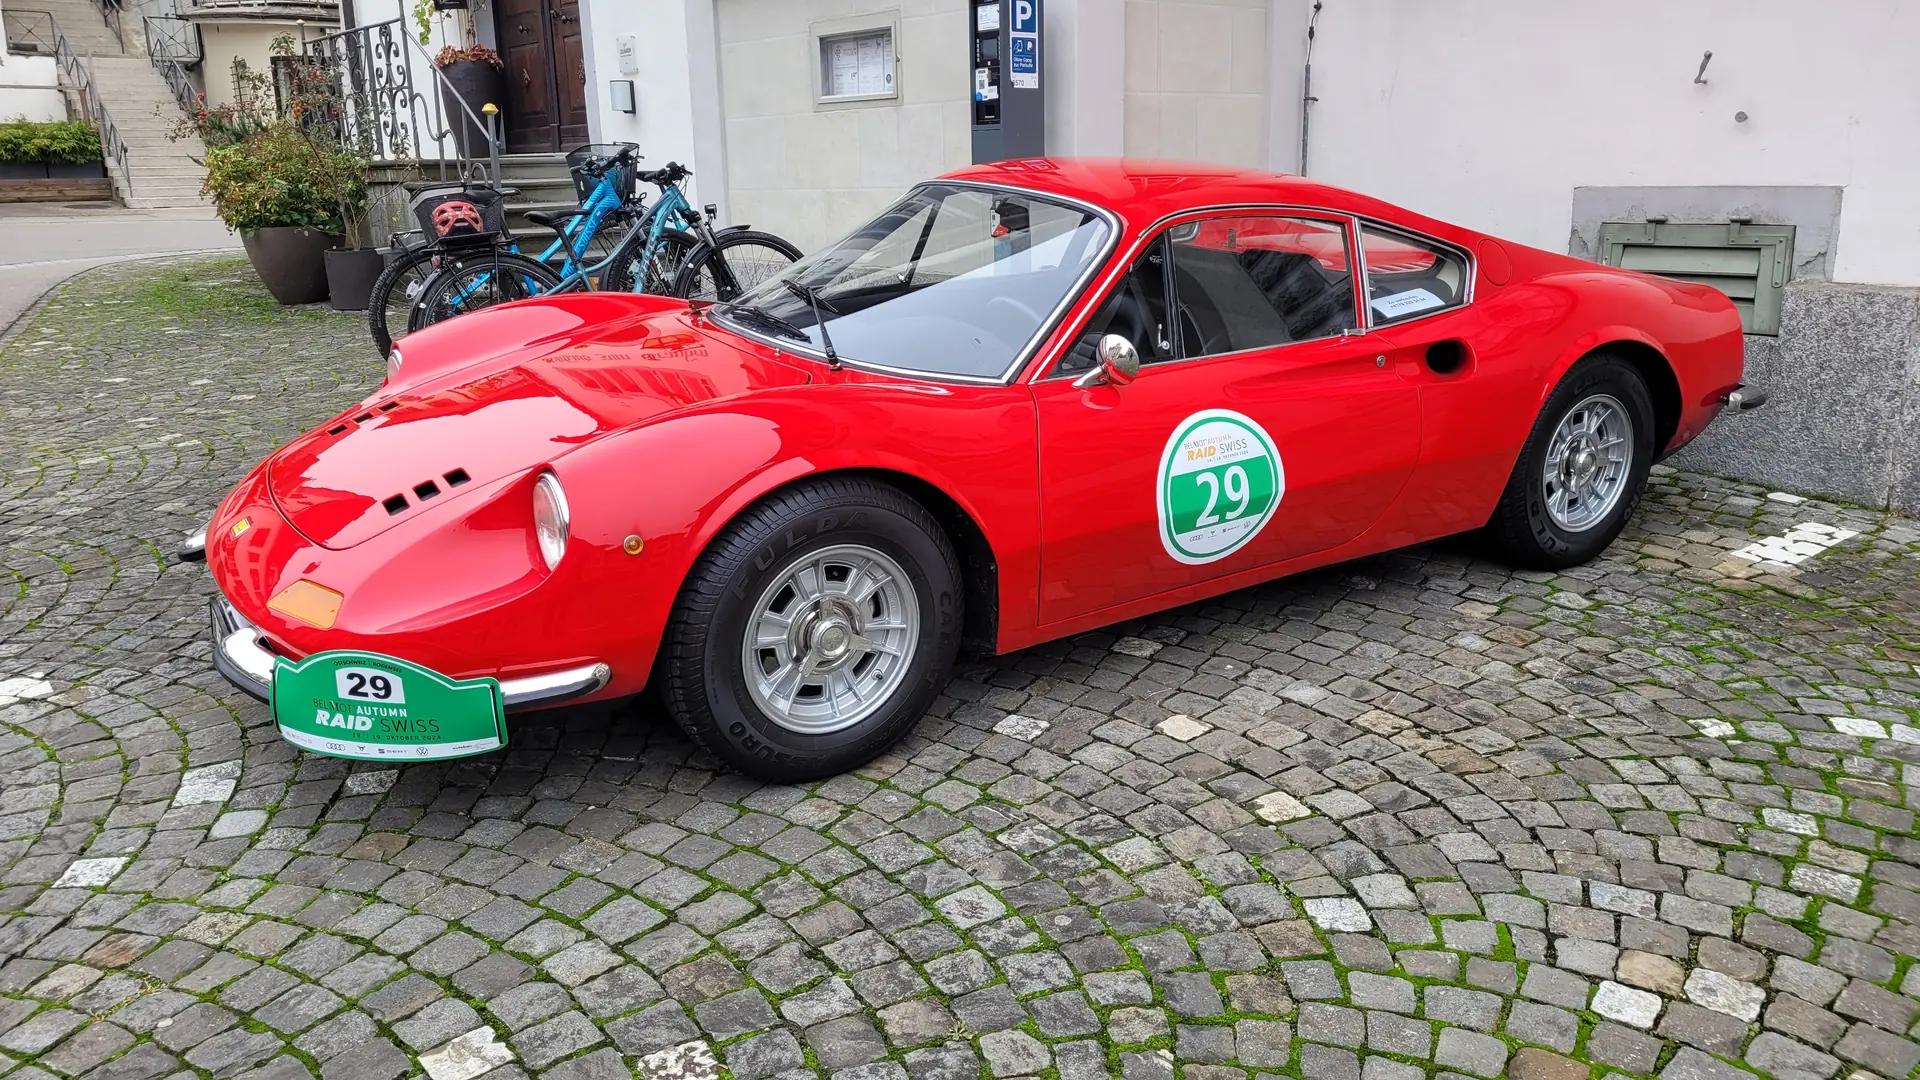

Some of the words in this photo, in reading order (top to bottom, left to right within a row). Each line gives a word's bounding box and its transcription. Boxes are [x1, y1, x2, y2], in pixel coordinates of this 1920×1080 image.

[1016, 0, 1032, 29] P
[1187, 445, 1217, 461] RAID
[1220, 438, 1248, 454] SWISS
[1195, 465, 1250, 528] 29
[732, 511, 868, 601] FULDA
[372, 661, 403, 673] BODENSEE
[346, 673, 392, 699] 29
[357, 705, 408, 718] AUTUMN
[380, 719, 440, 733] SWISS
